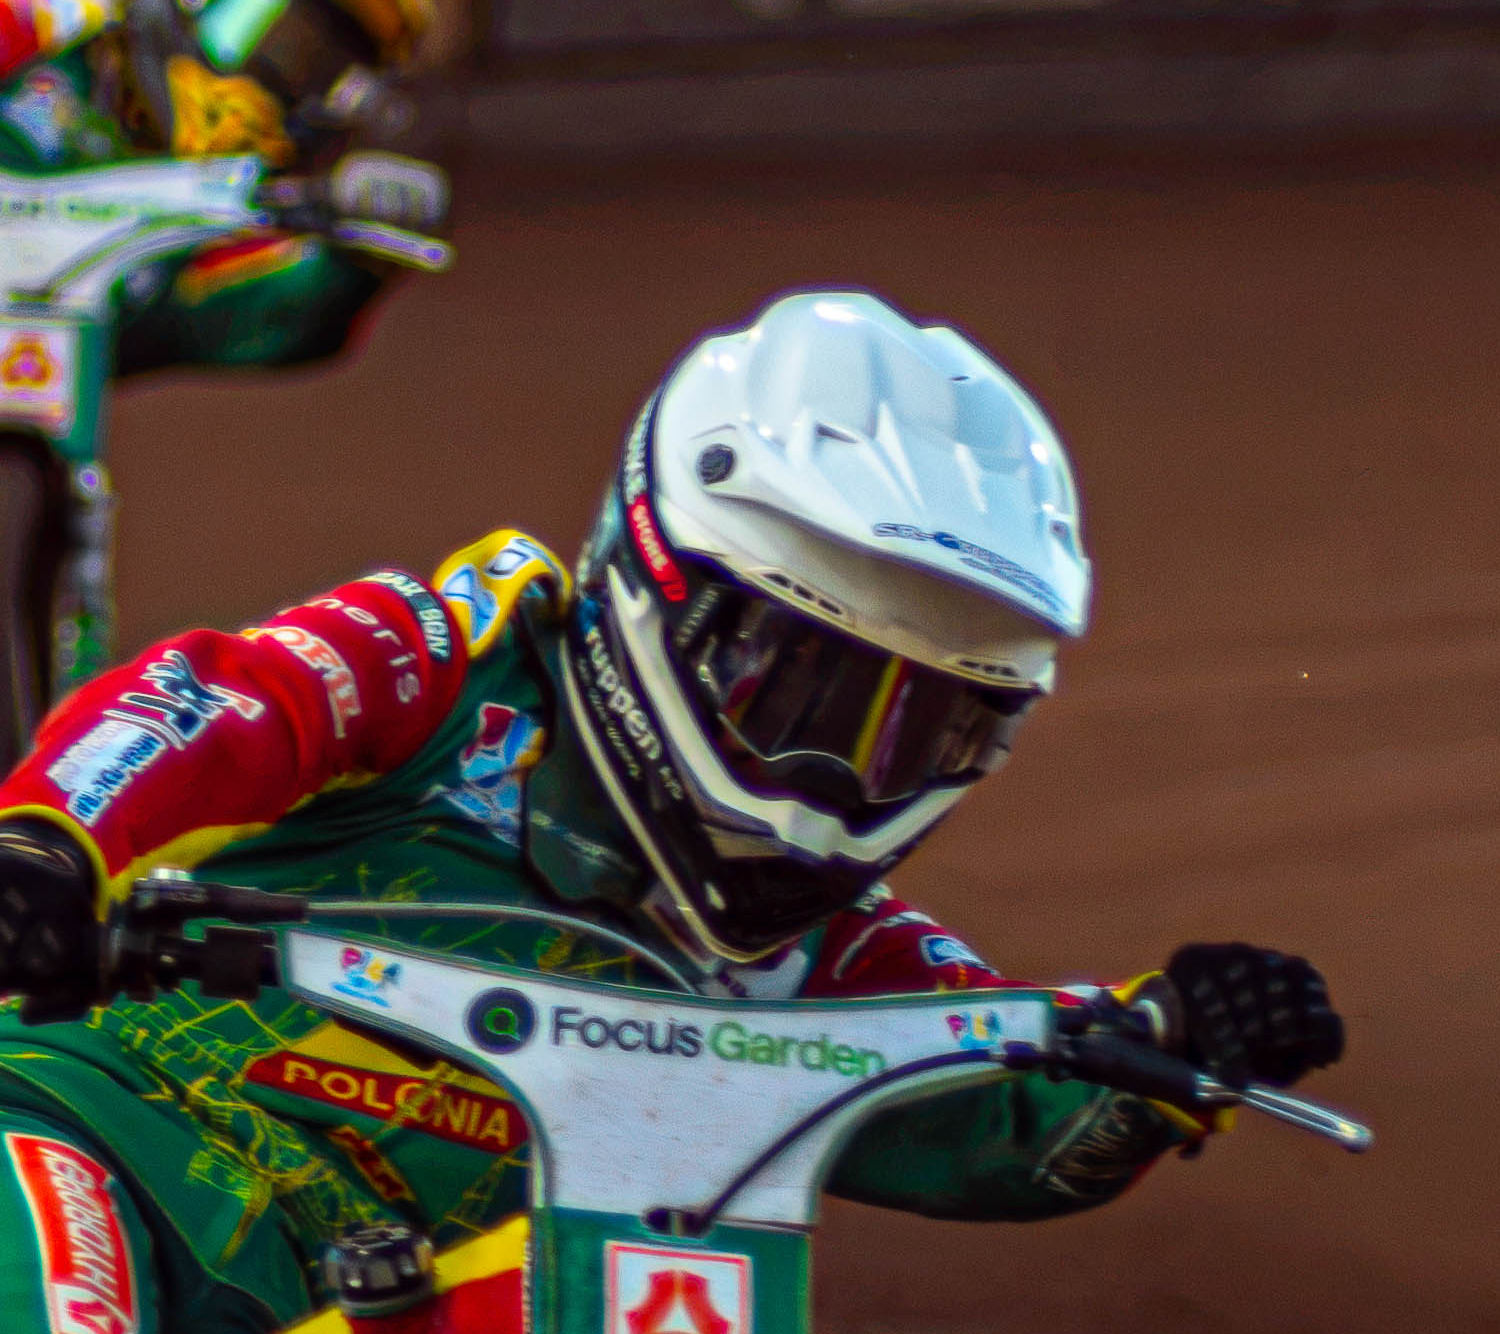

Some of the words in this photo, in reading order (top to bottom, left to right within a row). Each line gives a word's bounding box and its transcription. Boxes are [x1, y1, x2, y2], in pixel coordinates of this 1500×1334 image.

[550, 1005, 703, 1059] Focus
[707, 1020, 888, 1078] Garden
[282, 1059, 511, 1148] POLONIA
